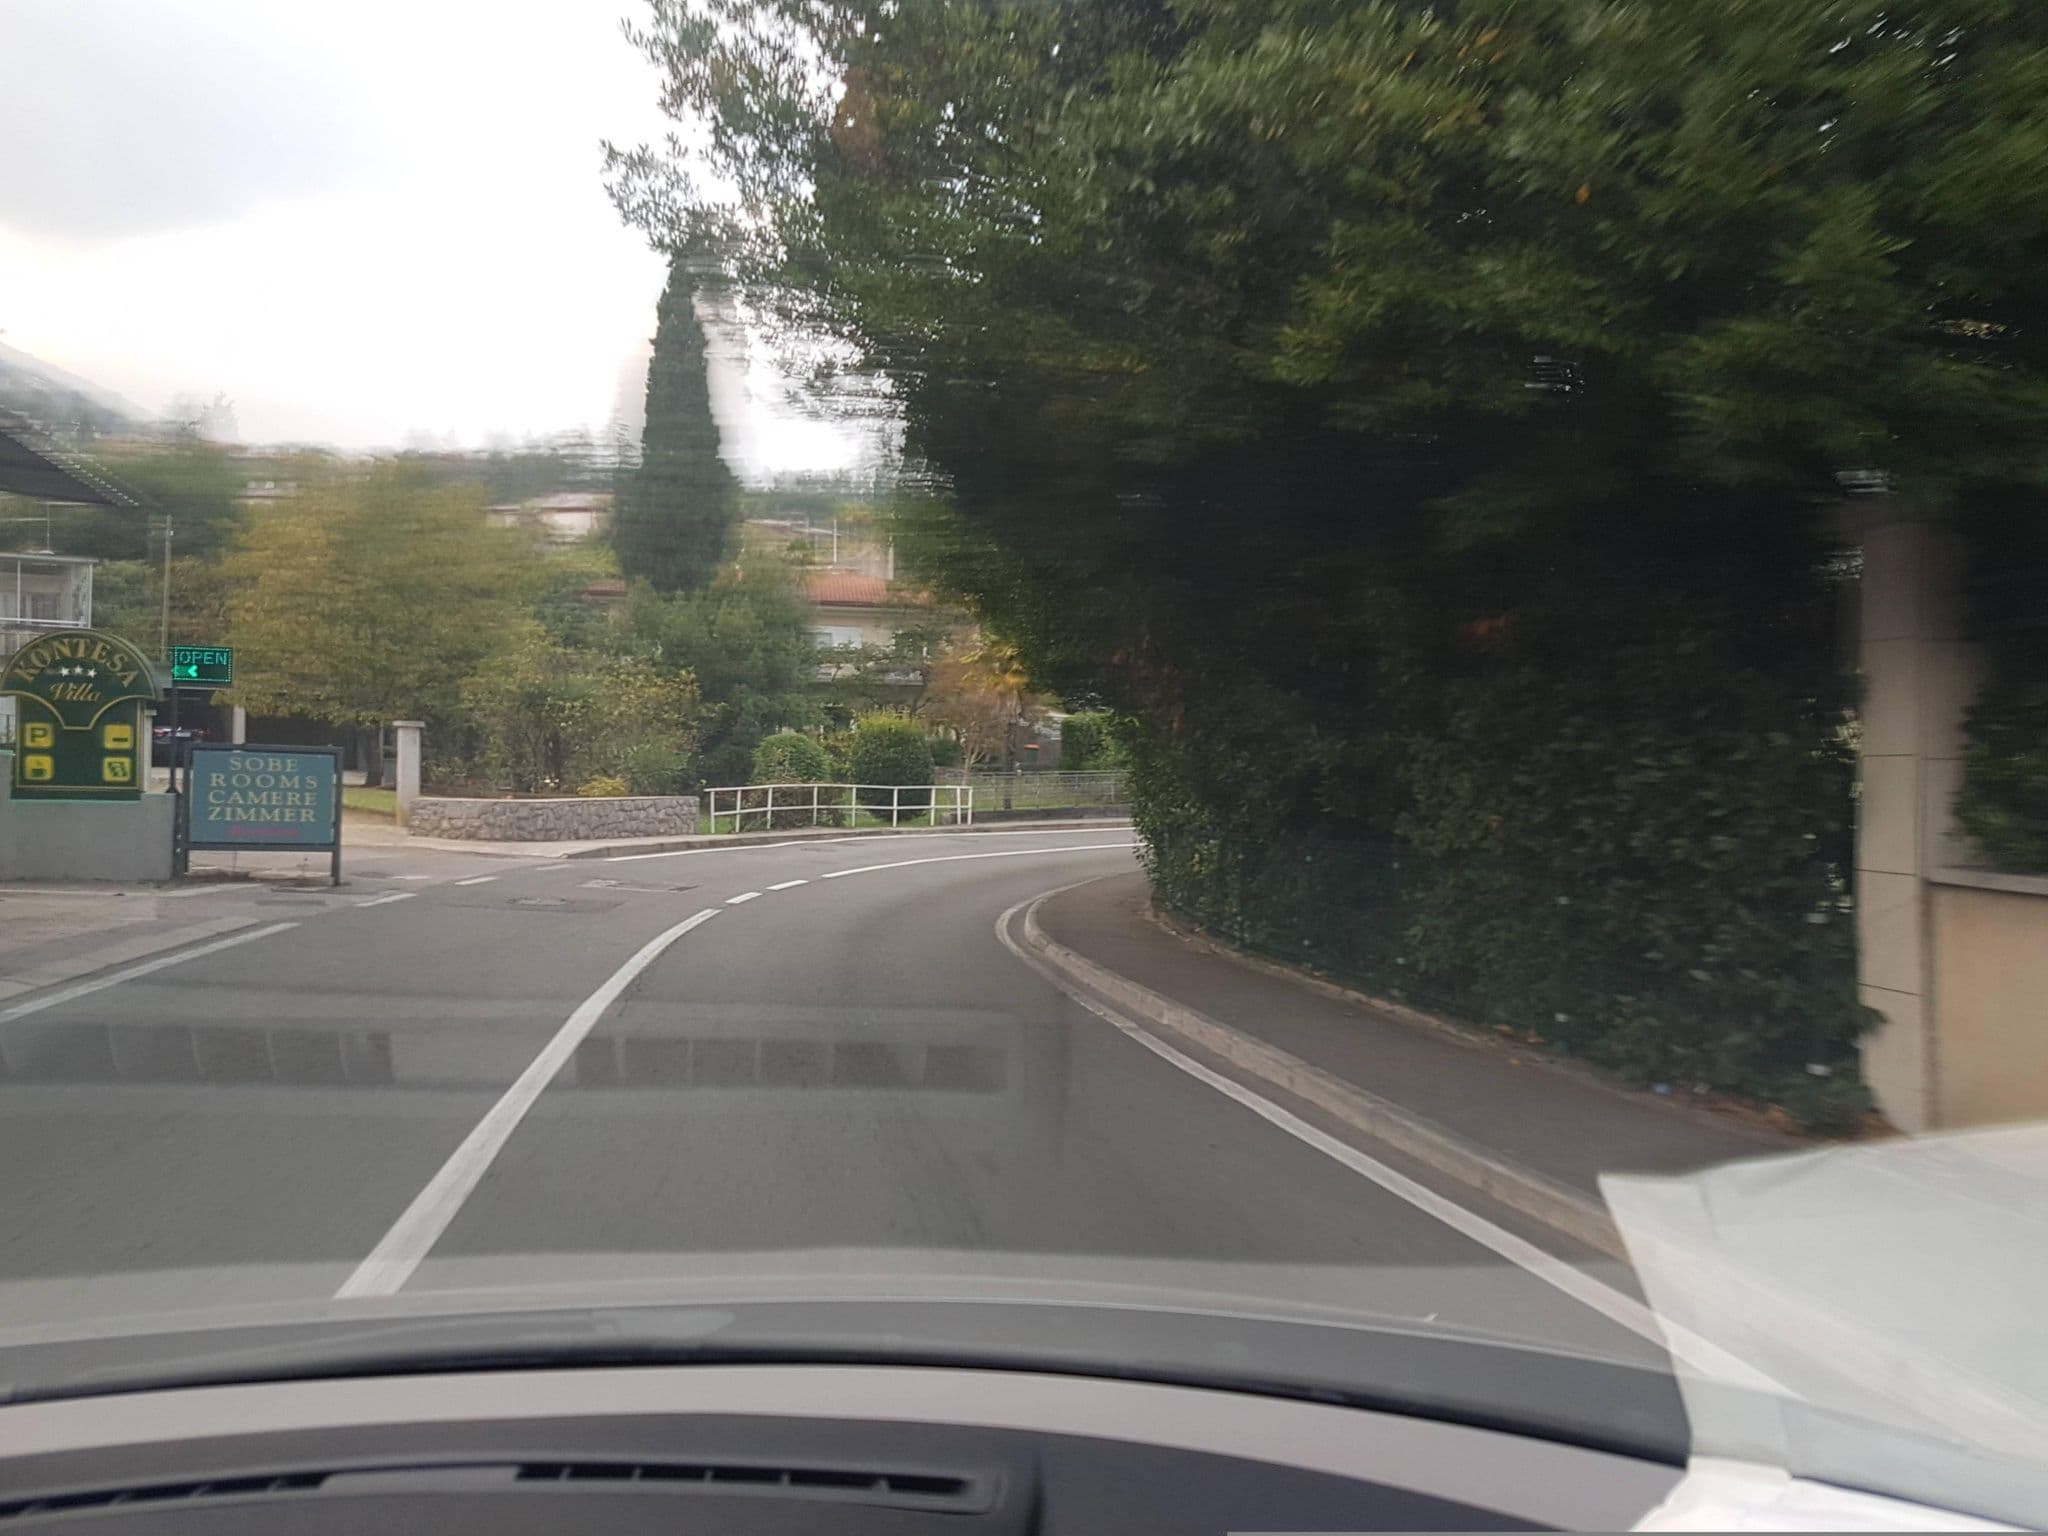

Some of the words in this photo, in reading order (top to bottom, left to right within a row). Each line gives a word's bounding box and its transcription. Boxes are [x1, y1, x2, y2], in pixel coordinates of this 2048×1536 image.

[14, 638, 139, 688] KONTESA
[178, 651, 228, 666] OPEN
[49, 682, 101, 702] Villa
[229, 757, 299, 772] SOBE
[210, 772, 318, 789] ROOMS
[208, 789, 318, 806] CAMERE
[207, 806, 316, 822] ZIMMER
